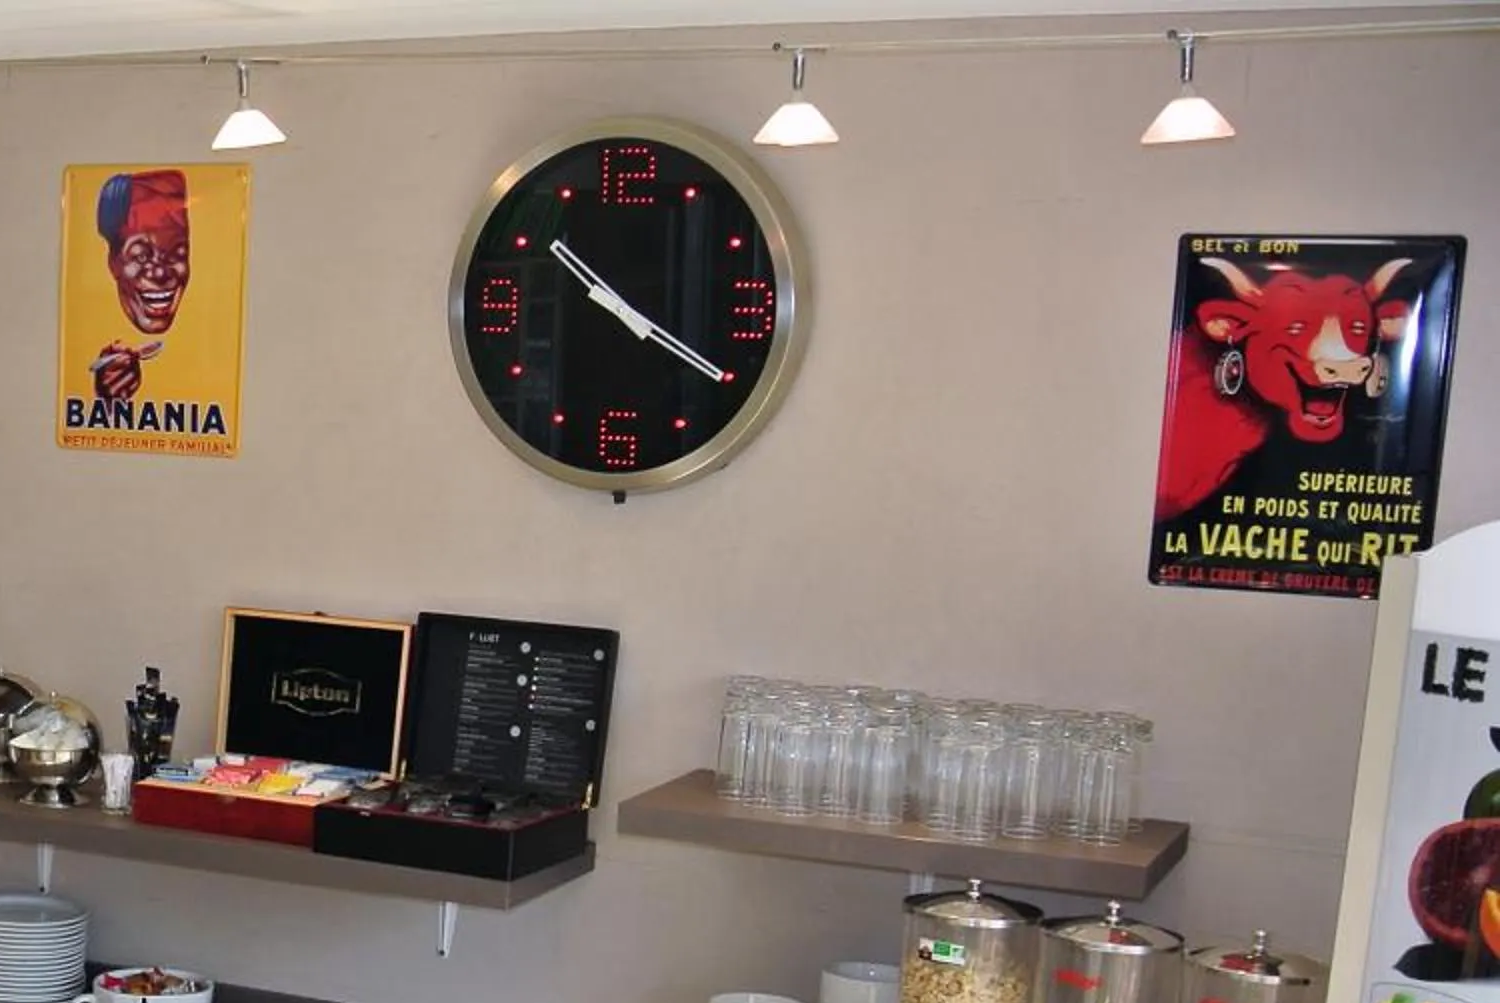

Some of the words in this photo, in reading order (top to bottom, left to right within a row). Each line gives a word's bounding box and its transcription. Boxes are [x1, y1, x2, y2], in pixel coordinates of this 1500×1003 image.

[602, 147, 656, 203] 12
[1259, 239, 1299, 254] BON
[482, 278, 518, 332] 9
[731, 281, 773, 338] 3
[65, 399, 226, 435] BANANIA
[599, 411, 637, 464] 6
[1299, 470, 1413, 496] SUPÉRIEURE
[1223, 496, 1244, 514] EN
[1255, 498, 1309, 519] POIDS
[1319, 502, 1342, 520] ET
[1348, 502, 1423, 525] QUALITÉ
[1165, 532, 1188, 554] LA
[1201, 523, 1309, 562] VACHE
[1317, 541, 1350, 568] QUI
[1361, 532, 1419, 566] RIT
[281, 680, 349, 702] Lipton
[1421, 641, 1489, 702] LE
